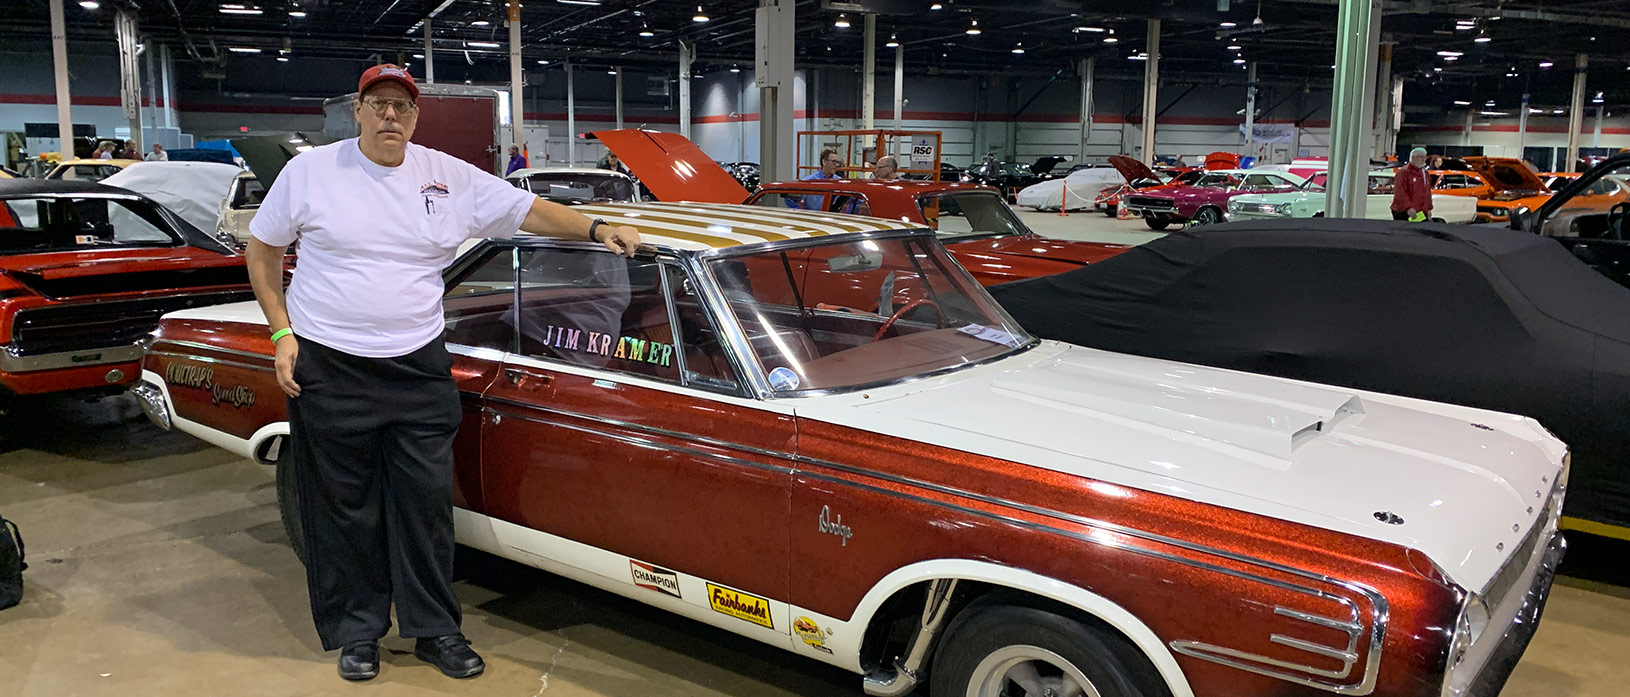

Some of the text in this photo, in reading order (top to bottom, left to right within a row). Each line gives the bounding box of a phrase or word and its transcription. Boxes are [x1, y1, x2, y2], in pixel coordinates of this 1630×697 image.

[913, 146, 931, 155] RSC
[543, 325, 673, 367] JIM KRAMER
[818, 504, 853, 547] Dodge
[634, 569, 677, 590] CHAMPION
[713, 587, 767, 619] Fairbanks
